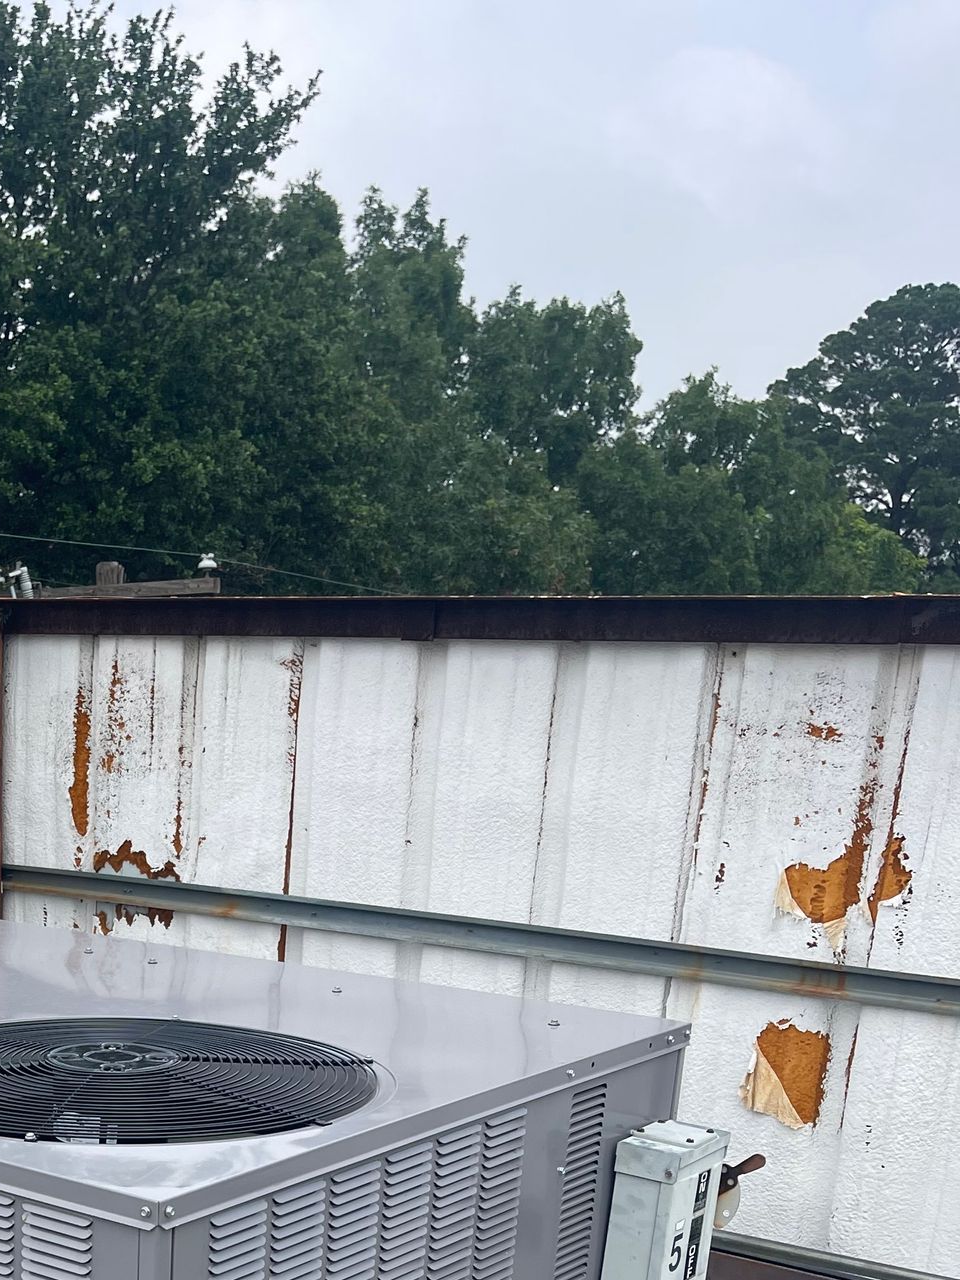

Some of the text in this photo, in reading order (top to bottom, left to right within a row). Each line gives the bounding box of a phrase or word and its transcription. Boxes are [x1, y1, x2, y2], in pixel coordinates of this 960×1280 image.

[698, 1171, 708, 1194] ON
[668, 1232, 684, 1273] 5
[686, 1244, 696, 1279] OFF
